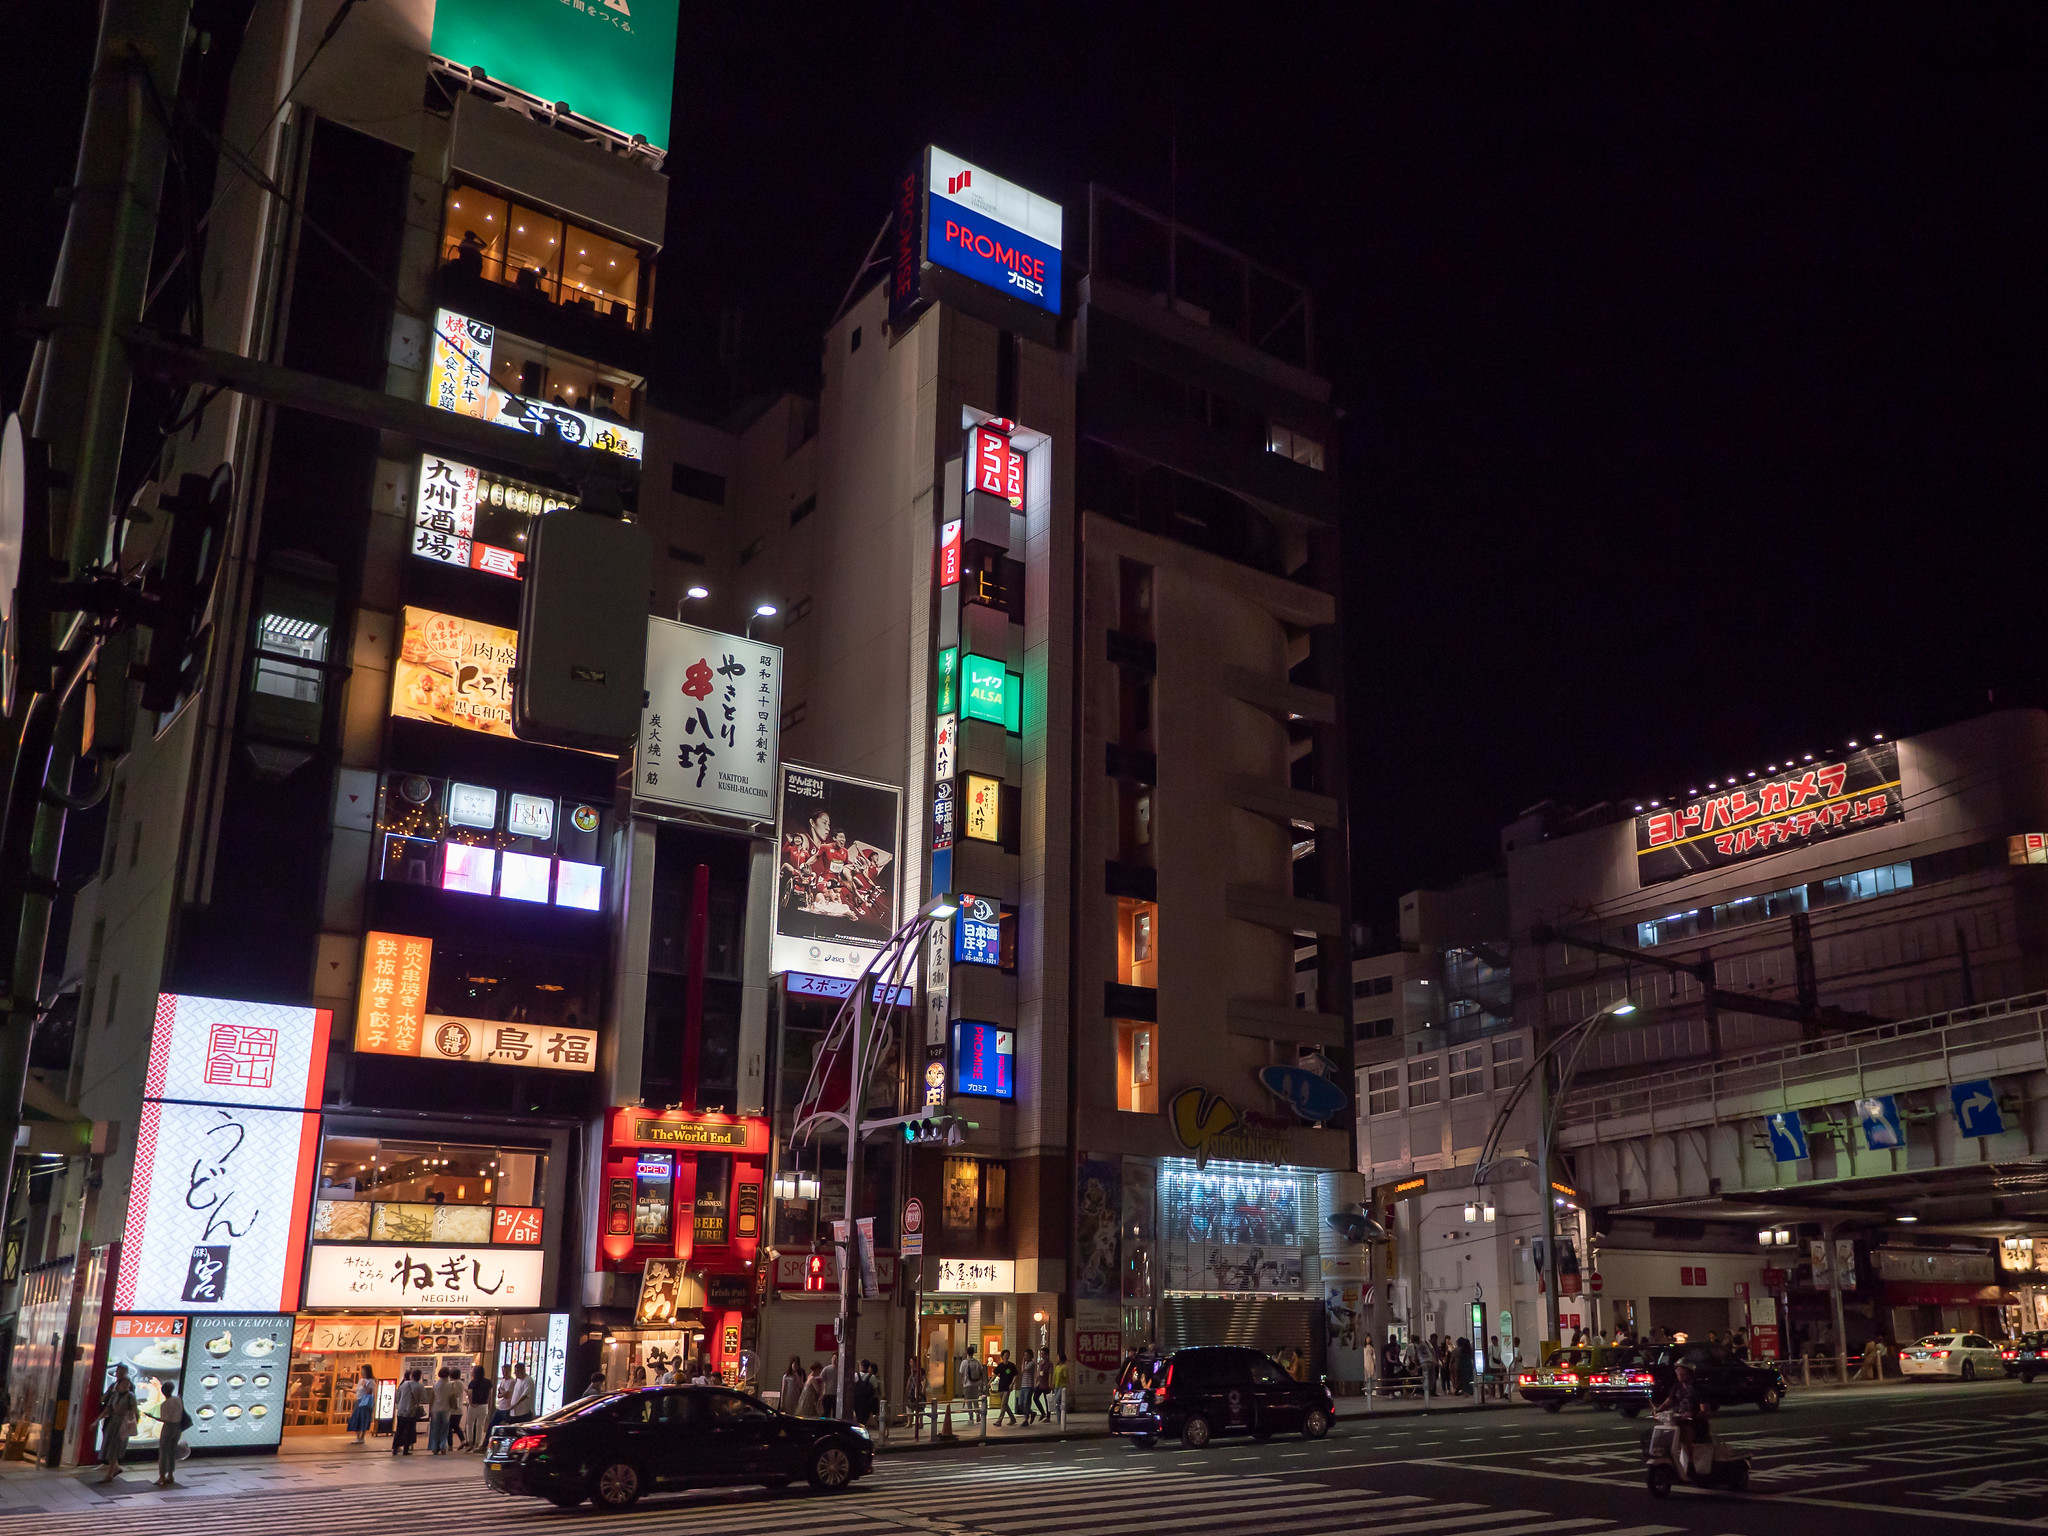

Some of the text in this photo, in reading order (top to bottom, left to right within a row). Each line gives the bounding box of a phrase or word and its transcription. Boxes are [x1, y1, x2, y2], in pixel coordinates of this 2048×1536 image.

[946, 220, 1045, 283] PROMISE
[1007, 271, 1044, 298] プロミス
[469, 322, 492, 340] 7F
[461, 349, 481, 404] 黒毛和牛
[982, 434, 1002, 494] アコム
[1009, 452, 1021, 494] アコム
[416, 459, 462, 561] 九州酒場
[946, 548, 956, 575] アコム
[944, 652, 953, 675] レイク
[971, 671, 1003, 689] レイク
[717, 654, 746, 748] やきとり
[971, 686, 1003, 704] ALSA
[755, 655, 772, 764] 昭和五十四年創業
[645, 713, 662, 786] 炭火焼一筋
[718, 771, 749, 785] YAKITORI
[718, 781, 769, 798] KUSHI-HACCHIN
[934, 801, 944, 825] 庄や
[1647, 763, 1847, 846] ヨドバシカメラ
[1715, 794, 1888, 855] マルチメディア上野
[963, 896, 974, 905] 4F
[964, 923, 998, 941] 日本海
[963, 936, 987, 951] 庄や
[367, 938, 399, 1048] 鉄板焼き餃子
[488, 1027, 591, 1065] 鳥福
[973, 1026, 984, 1080] PROMISE
[967, 1083, 988, 1093] プロミス
[651, 1128, 732, 1144] The World End
[186, 1110, 260, 1242] うどん
[638, 1165, 668, 1174] OPEN
[697, 1199, 723, 1207] GUINNESS
[320, 1204, 334, 1232] 牛たん
[693, 1217, 723, 1230] BEER
[344, 1256, 375, 1267] 牛たん
[358, 1270, 384, 1279] とろろ
[390, 1252, 505, 1295] ねぎし
[349, 1281, 375, 1292] 麦めし
[421, 1294, 469, 1303] NEGISHI
[132, 1319, 171, 1335] うどん
[320, 1328, 369, 1349] うどん
[1078, 1334, 1119, 1352] 免税店
[1079, 1353, 1119, 1362] Tax Free
[547, 1346, 566, 1394] ねぎし
